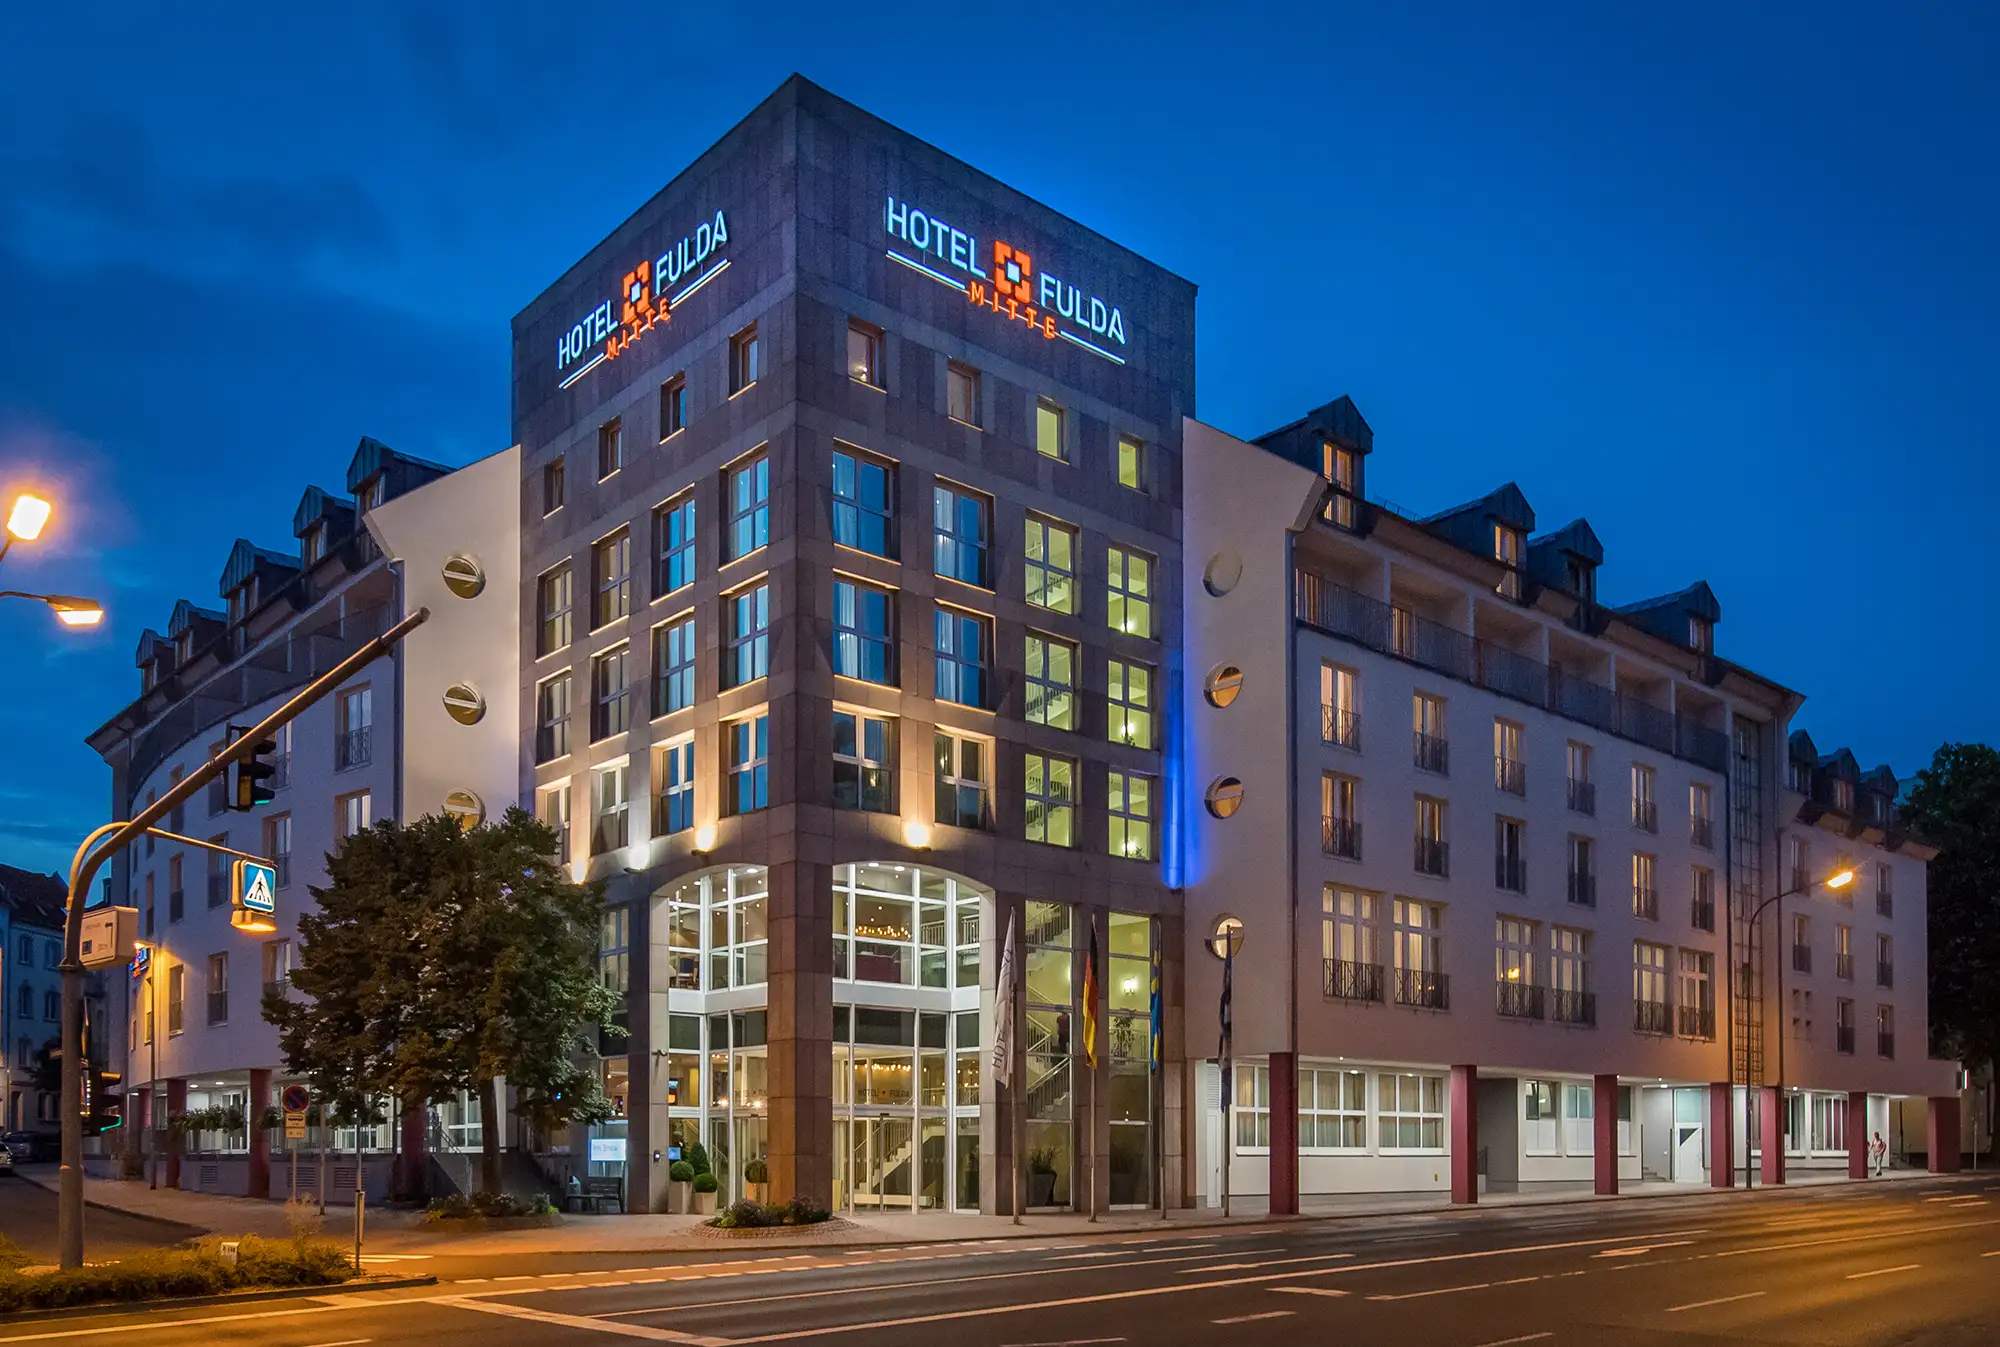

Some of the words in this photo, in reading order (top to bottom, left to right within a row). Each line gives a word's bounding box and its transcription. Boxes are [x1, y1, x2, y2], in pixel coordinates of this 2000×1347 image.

[558, 300, 618, 370] HOTEL
[655, 209, 728, 296] FULDA
[887, 195, 987, 279] HOTEL
[1040, 271, 1126, 345] FULDA
[969, 281, 1056, 339] MITTE
[606, 298, 671, 360] MITTE
